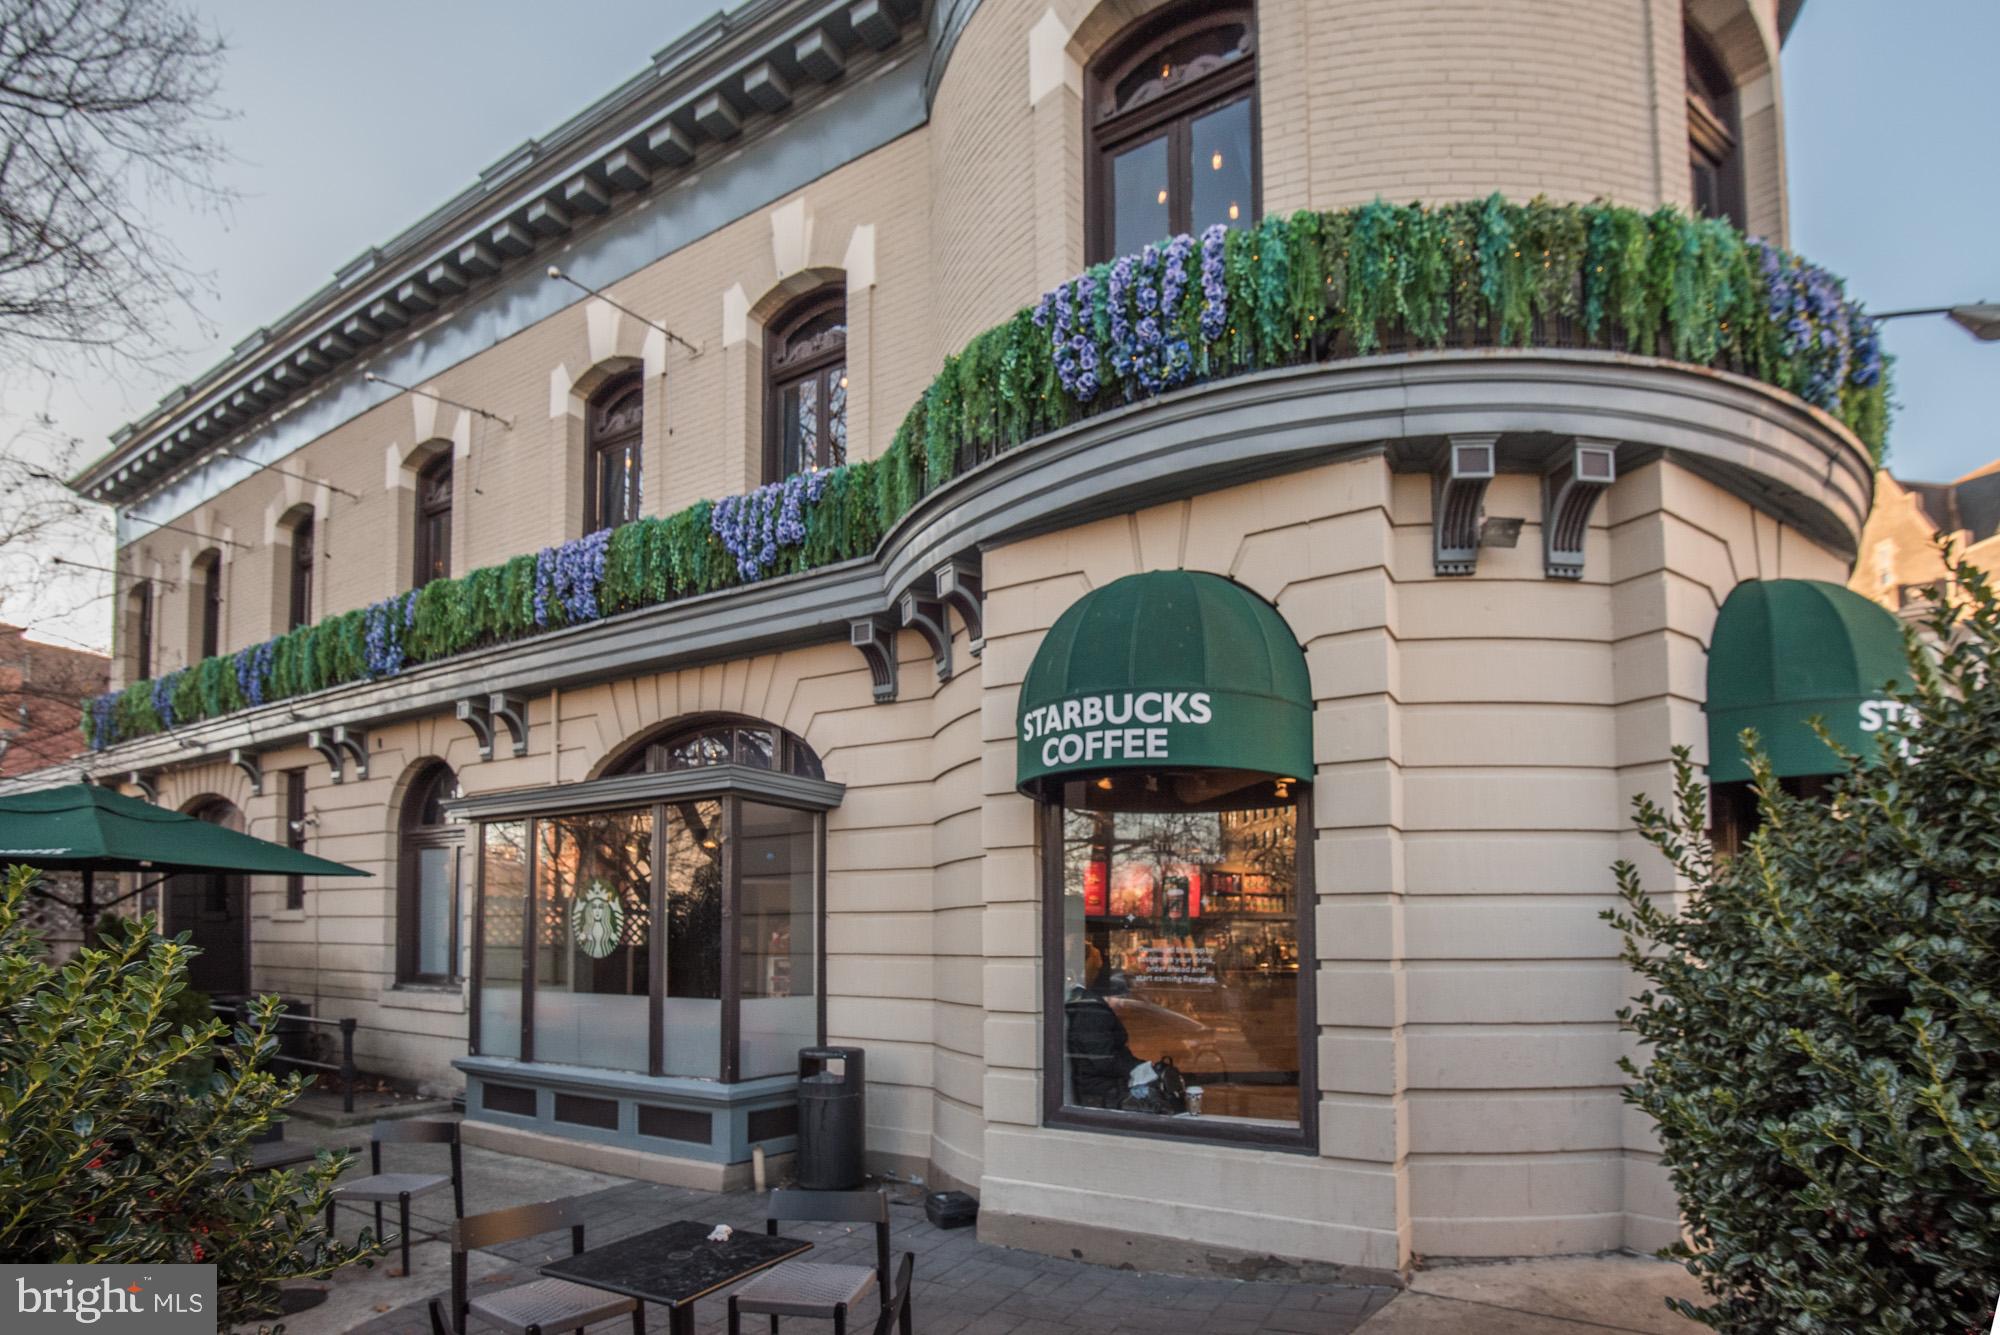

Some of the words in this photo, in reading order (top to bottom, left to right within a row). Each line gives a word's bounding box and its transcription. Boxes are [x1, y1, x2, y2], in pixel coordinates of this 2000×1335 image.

[1023, 691, 1212, 742] STARBUCKS
[1041, 727, 1169, 767] COFFEE
[1135, 975, 1153, 983] start
[1154, 976, 1182, 985] earning
[1192, 966, 1207, 975] and
